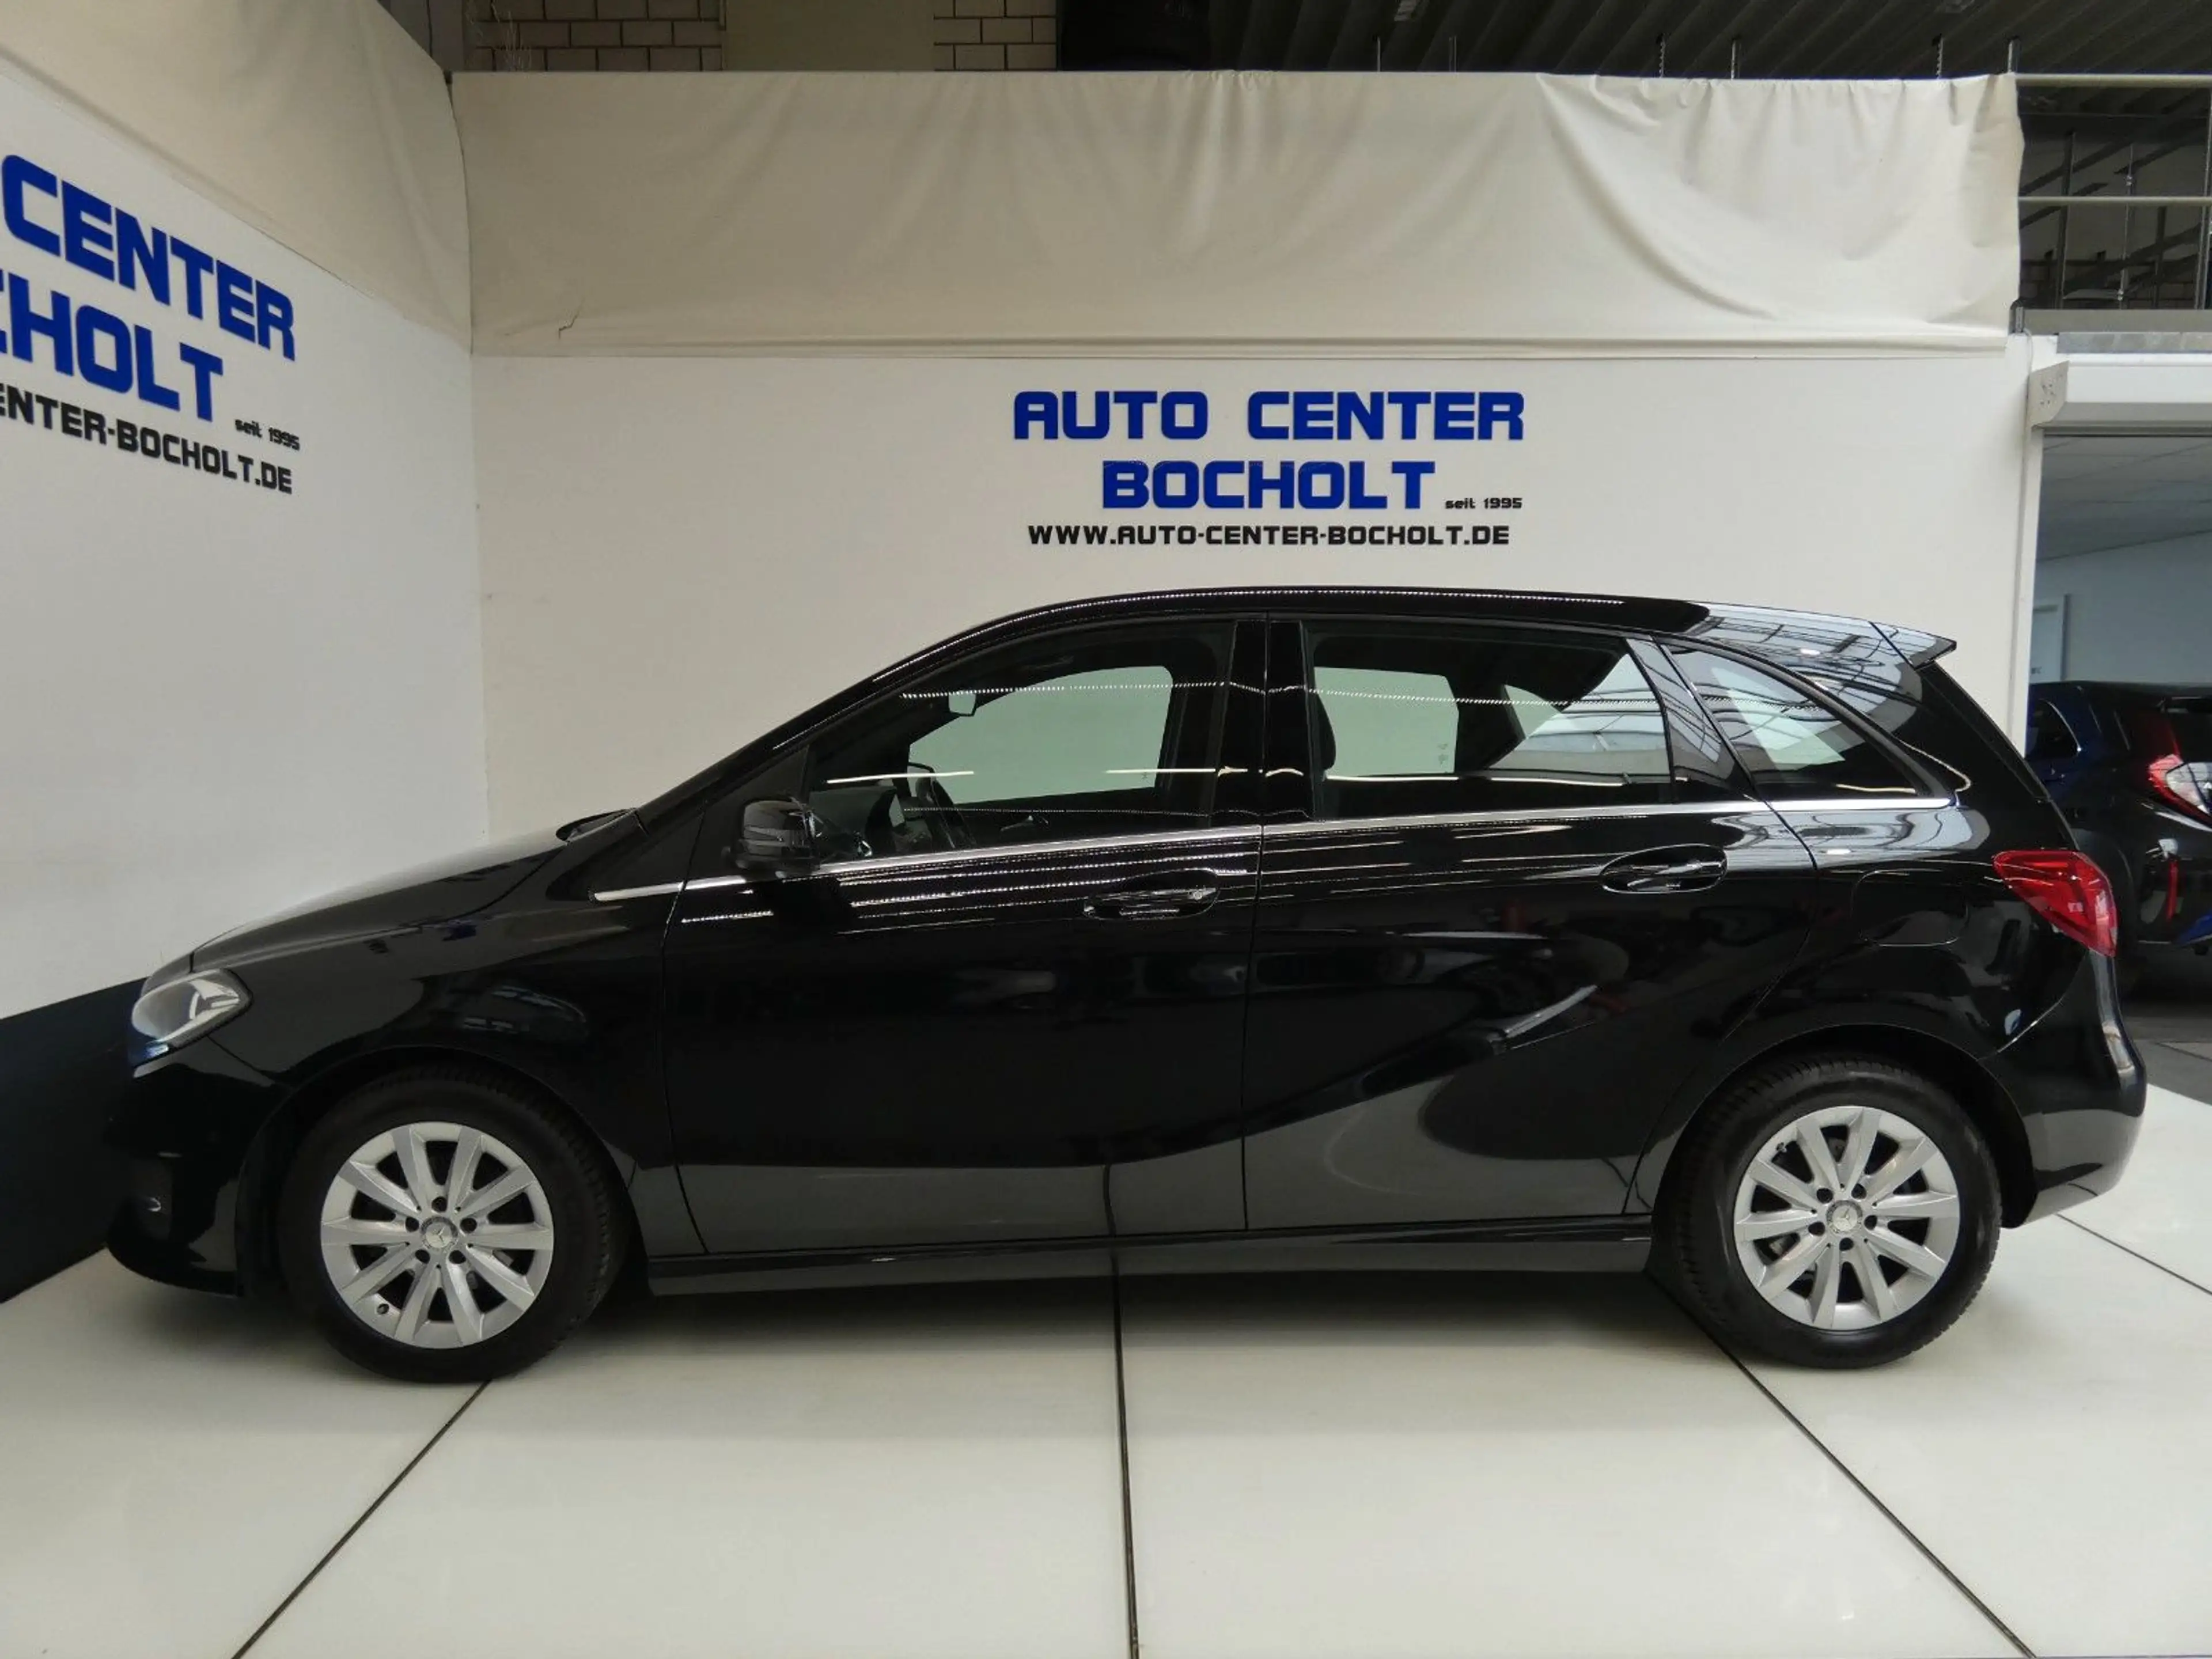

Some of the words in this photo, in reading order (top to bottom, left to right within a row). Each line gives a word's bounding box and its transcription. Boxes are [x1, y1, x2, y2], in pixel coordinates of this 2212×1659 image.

[1, 154, 296, 362] CENTER
[0, 269, 224, 422] HOLT
[0, 382, 293, 494] NTER-BOCHOLT.DE
[234, 419, 262, 438] seit
[268, 427, 300, 451] 1995
[1013, 391, 1209, 440] AUTO
[1248, 391, 1524, 440] CENTER
[1103, 460, 1435, 509] BOCHOLT
[1445, 498, 1476, 509] seit
[1483, 497, 1522, 509] 1995
[1028, 525, 1509, 545] WWW.AUTO-CENTER-BOCHOLT.DE
